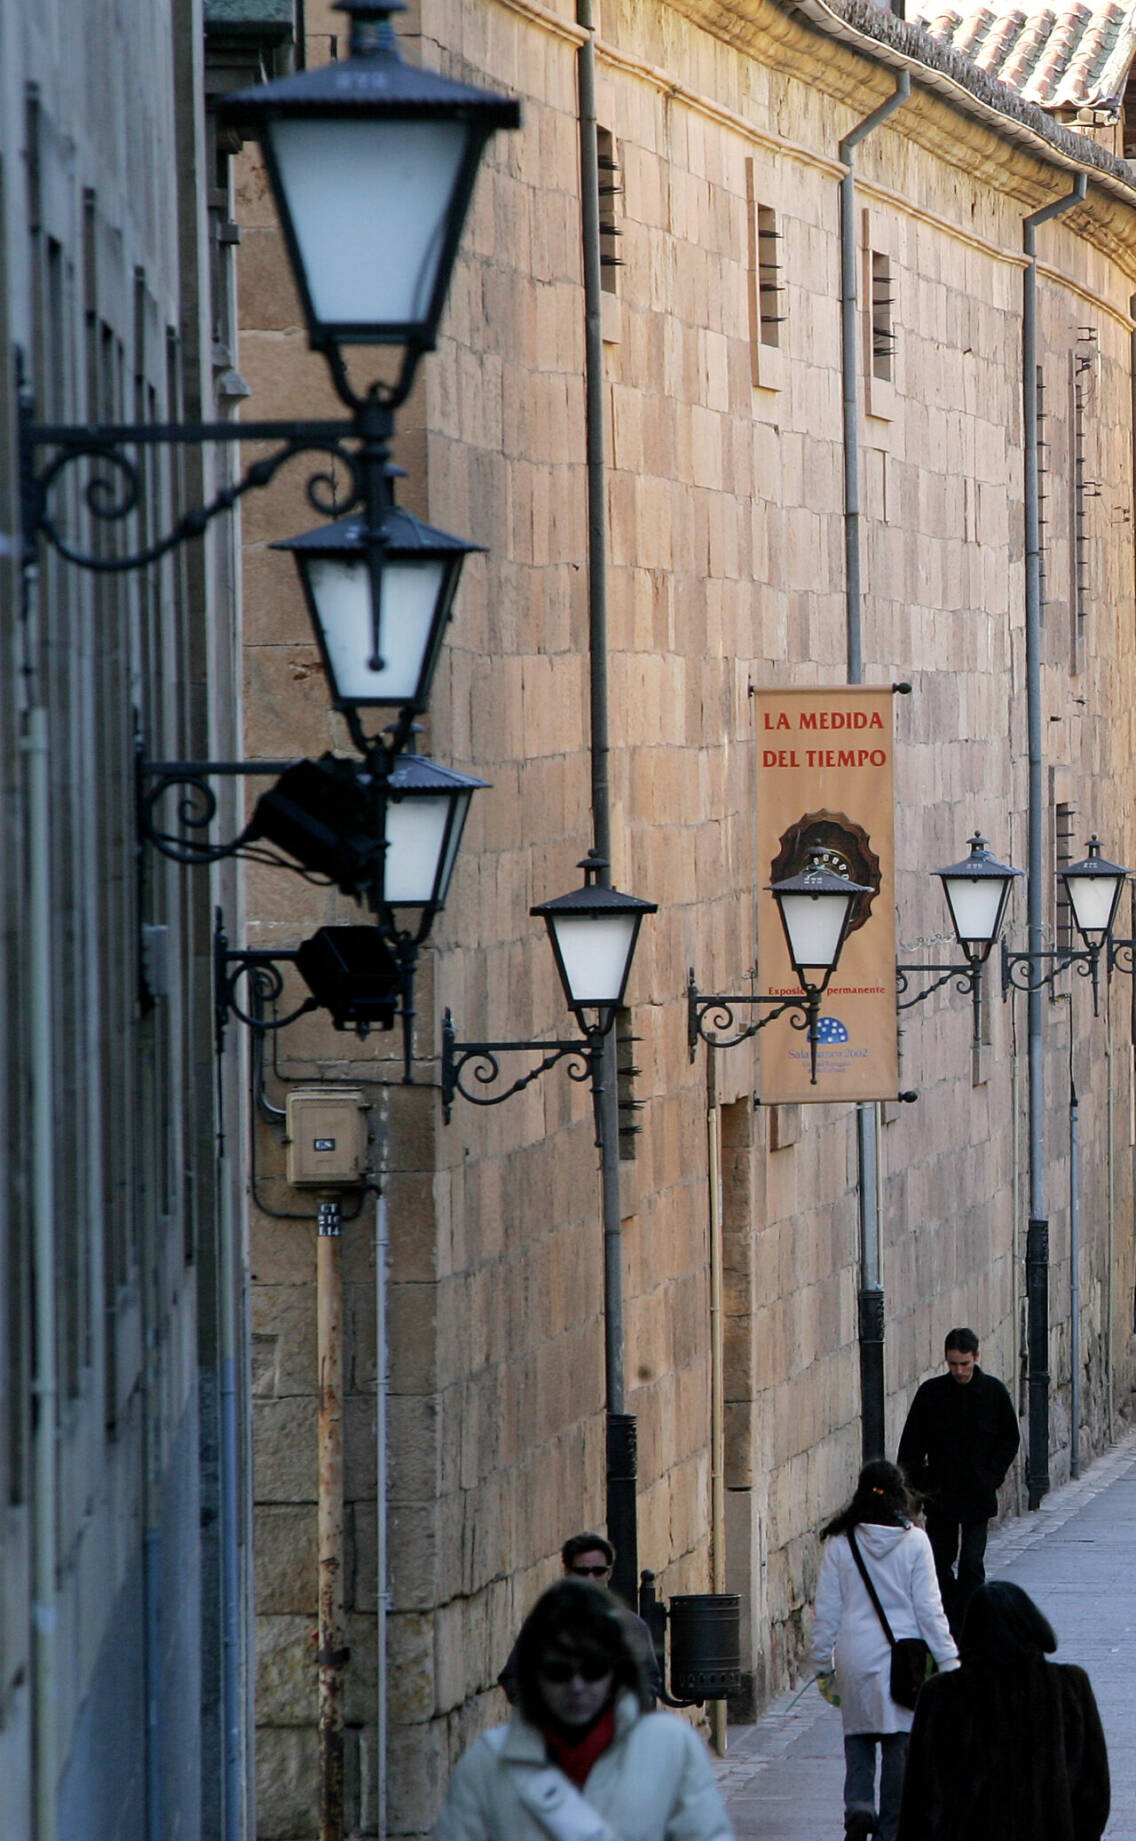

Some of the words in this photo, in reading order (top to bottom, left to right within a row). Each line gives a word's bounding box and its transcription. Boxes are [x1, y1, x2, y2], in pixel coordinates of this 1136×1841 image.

[764, 713, 791, 730] LA
[799, 712, 884, 730] MEDIDA
[763, 750, 800, 768] DEL
[806, 749, 887, 767] TIEMPO
[826, 986, 886, 997] permanente
